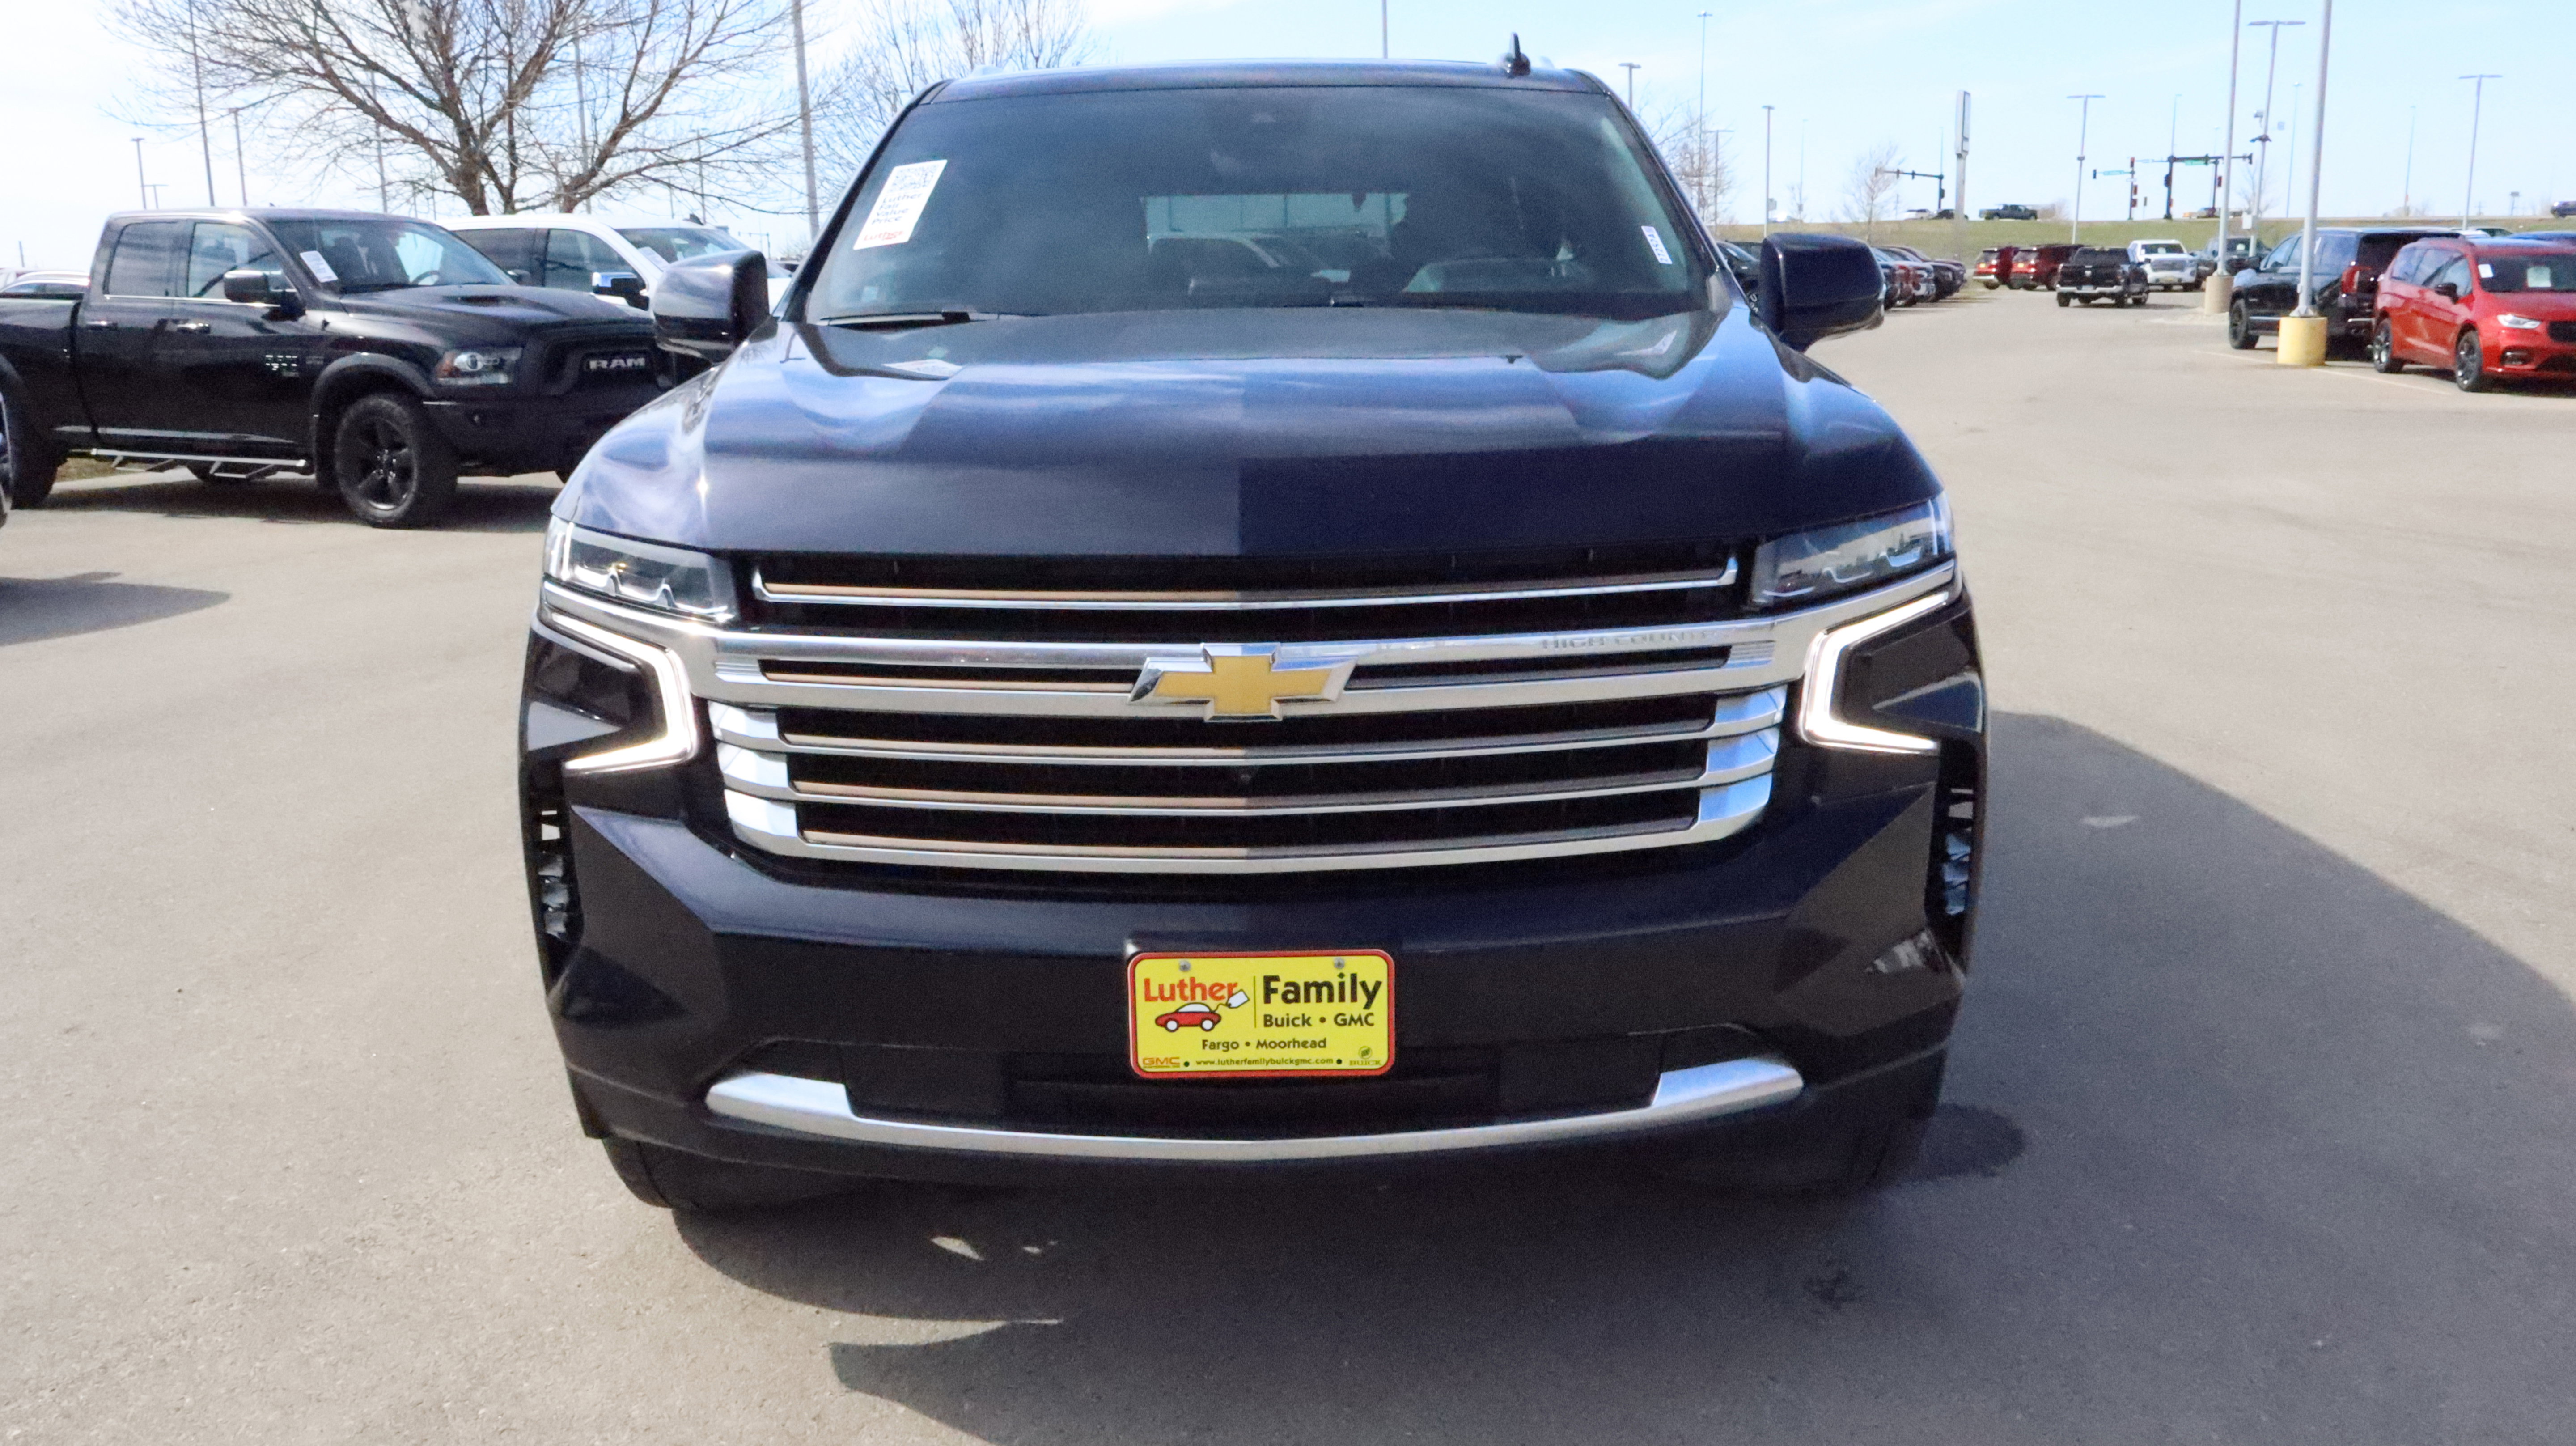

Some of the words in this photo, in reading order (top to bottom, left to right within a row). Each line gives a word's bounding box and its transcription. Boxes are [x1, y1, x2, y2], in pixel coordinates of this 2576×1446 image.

[589, 358, 645, 370] RAM
[1144, 976, 1238, 1002] Luther
[1263, 972, 1383, 1010] Family
[1263, 1013, 1313, 1027] Buick
[1334, 1012, 1375, 1026] GMC
[1202, 1039, 1239, 1052] Fargo
[1256, 1038, 1327, 1049] Moorhead
[1143, 1057, 1181, 1066] GMC
[1195, 1057, 1333, 1066] www.lutherfamilybuickgmc.com
